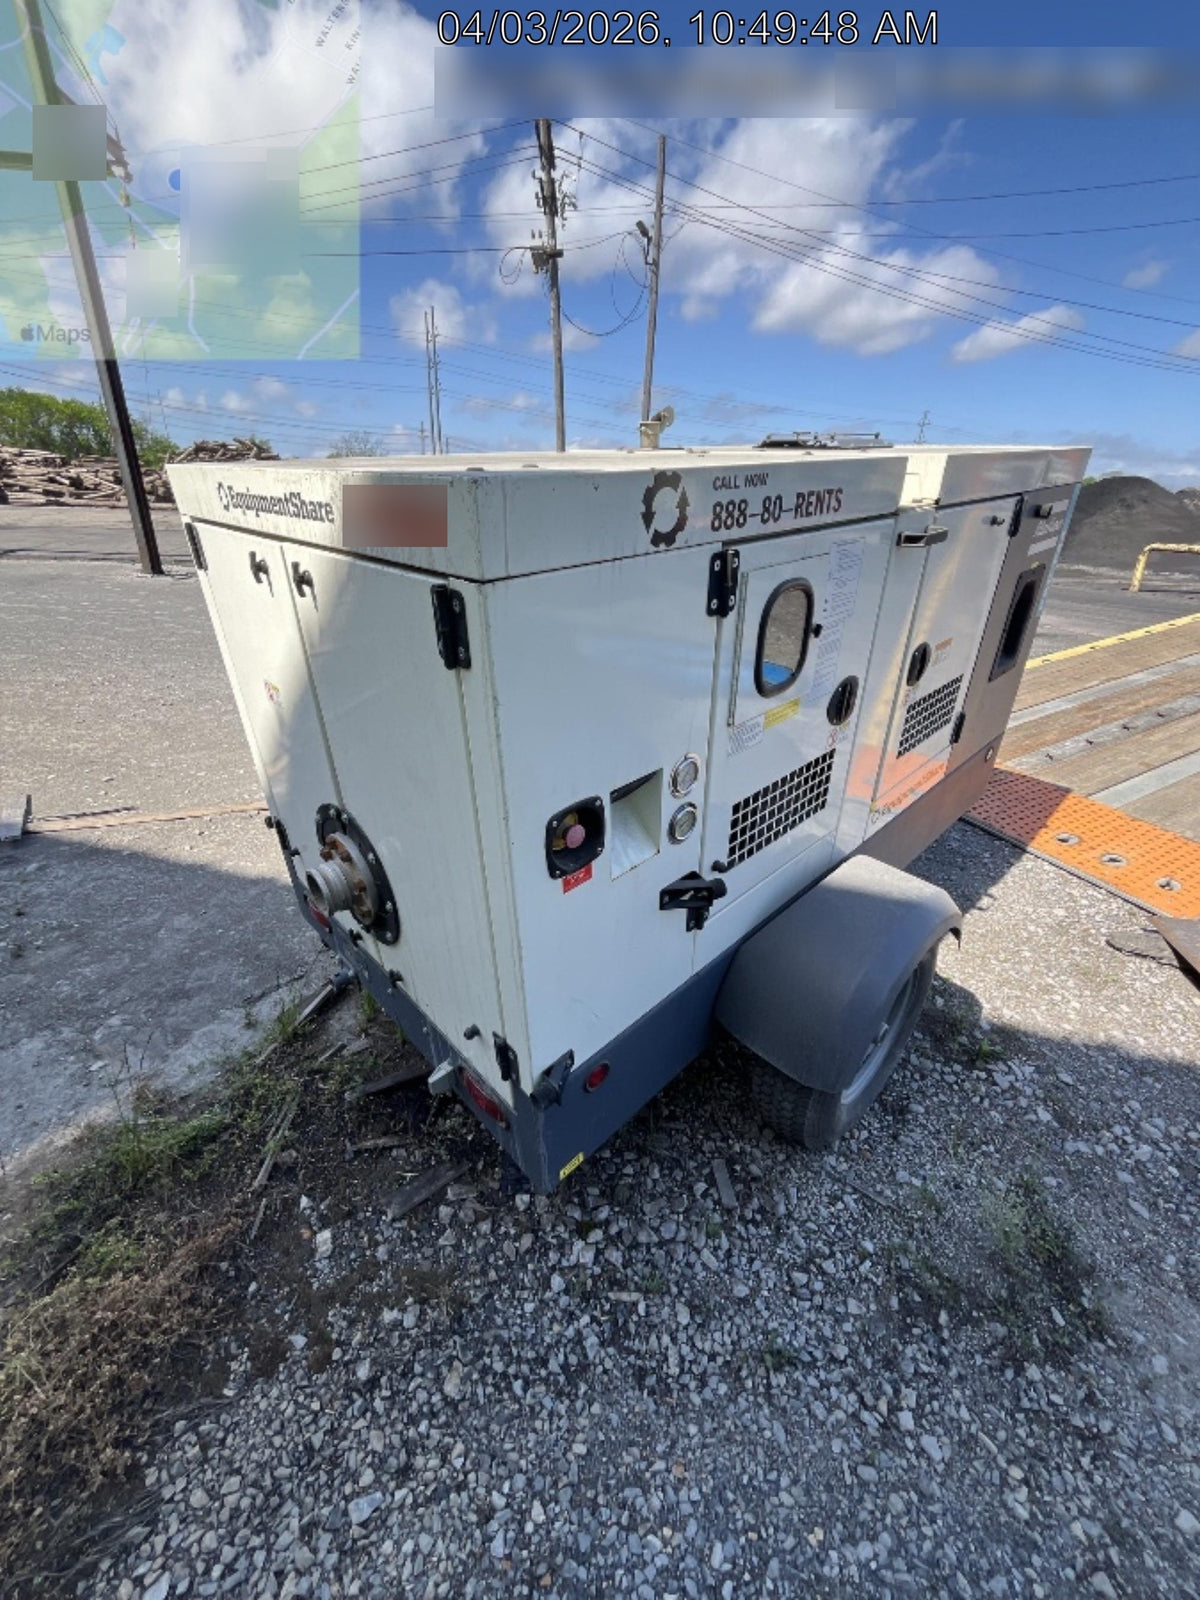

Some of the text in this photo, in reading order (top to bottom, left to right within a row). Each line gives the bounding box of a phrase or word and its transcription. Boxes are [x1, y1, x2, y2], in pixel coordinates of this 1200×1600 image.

[712, 472, 769, 491] CALL NOW
[227, 485, 335, 523] EquipmentShare
[710, 487, 843, 532] 888-80-RENTS
